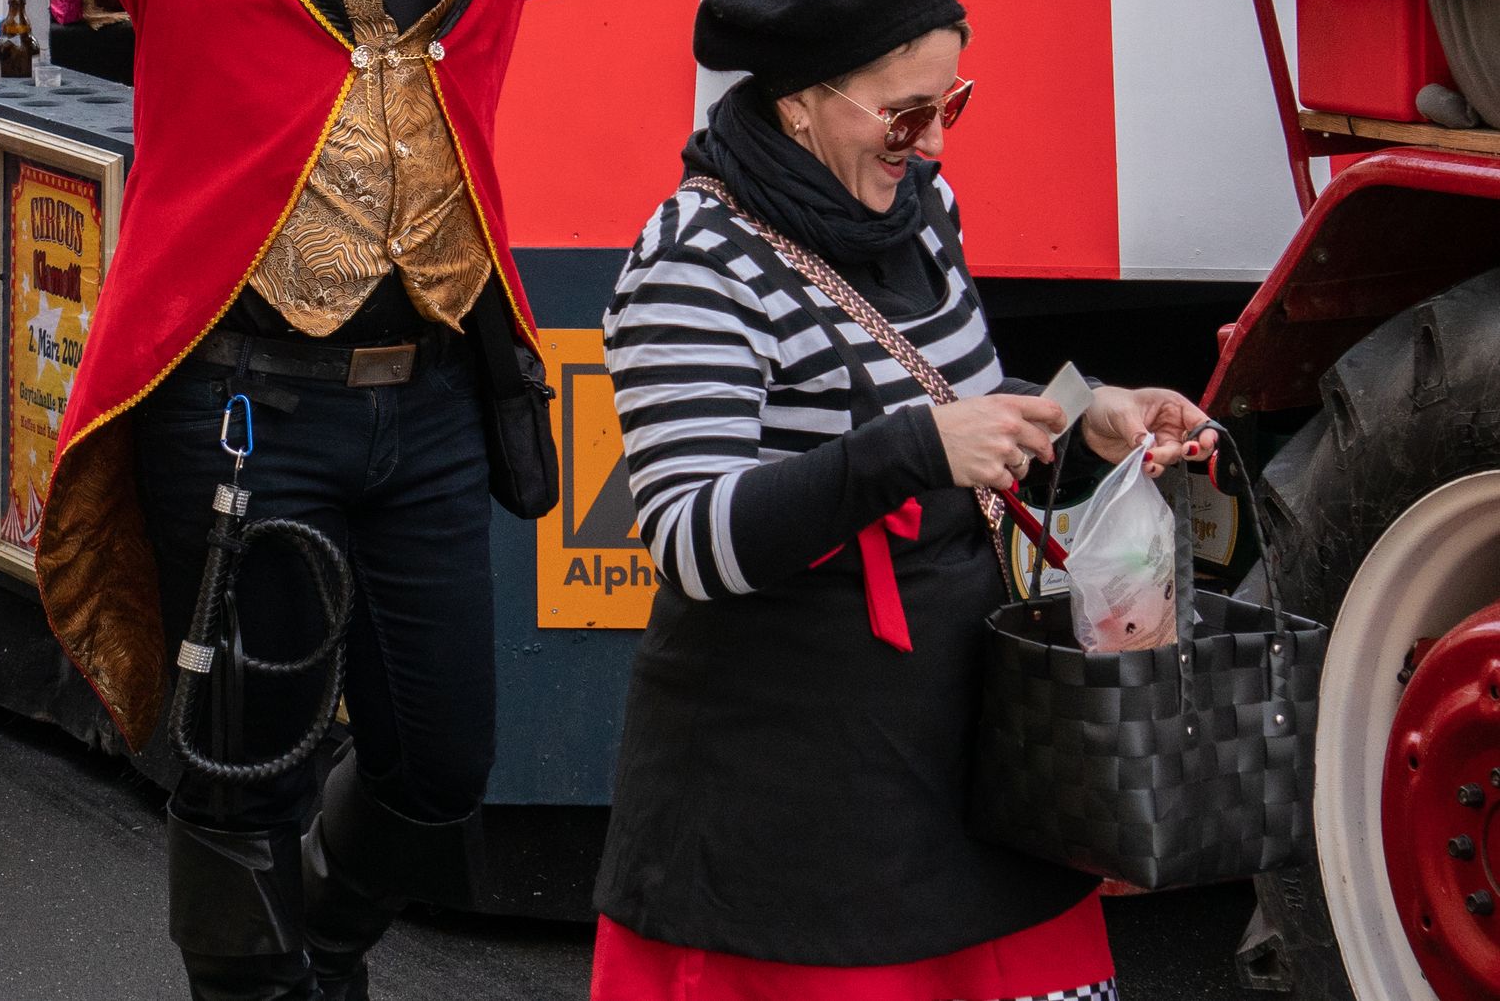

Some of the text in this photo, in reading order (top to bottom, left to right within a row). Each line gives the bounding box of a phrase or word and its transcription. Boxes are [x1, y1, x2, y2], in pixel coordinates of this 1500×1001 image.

[30, 196, 85, 257] CIRCUS
[27, 324, 37, 353] 2.
[37, 327, 61, 363] März
